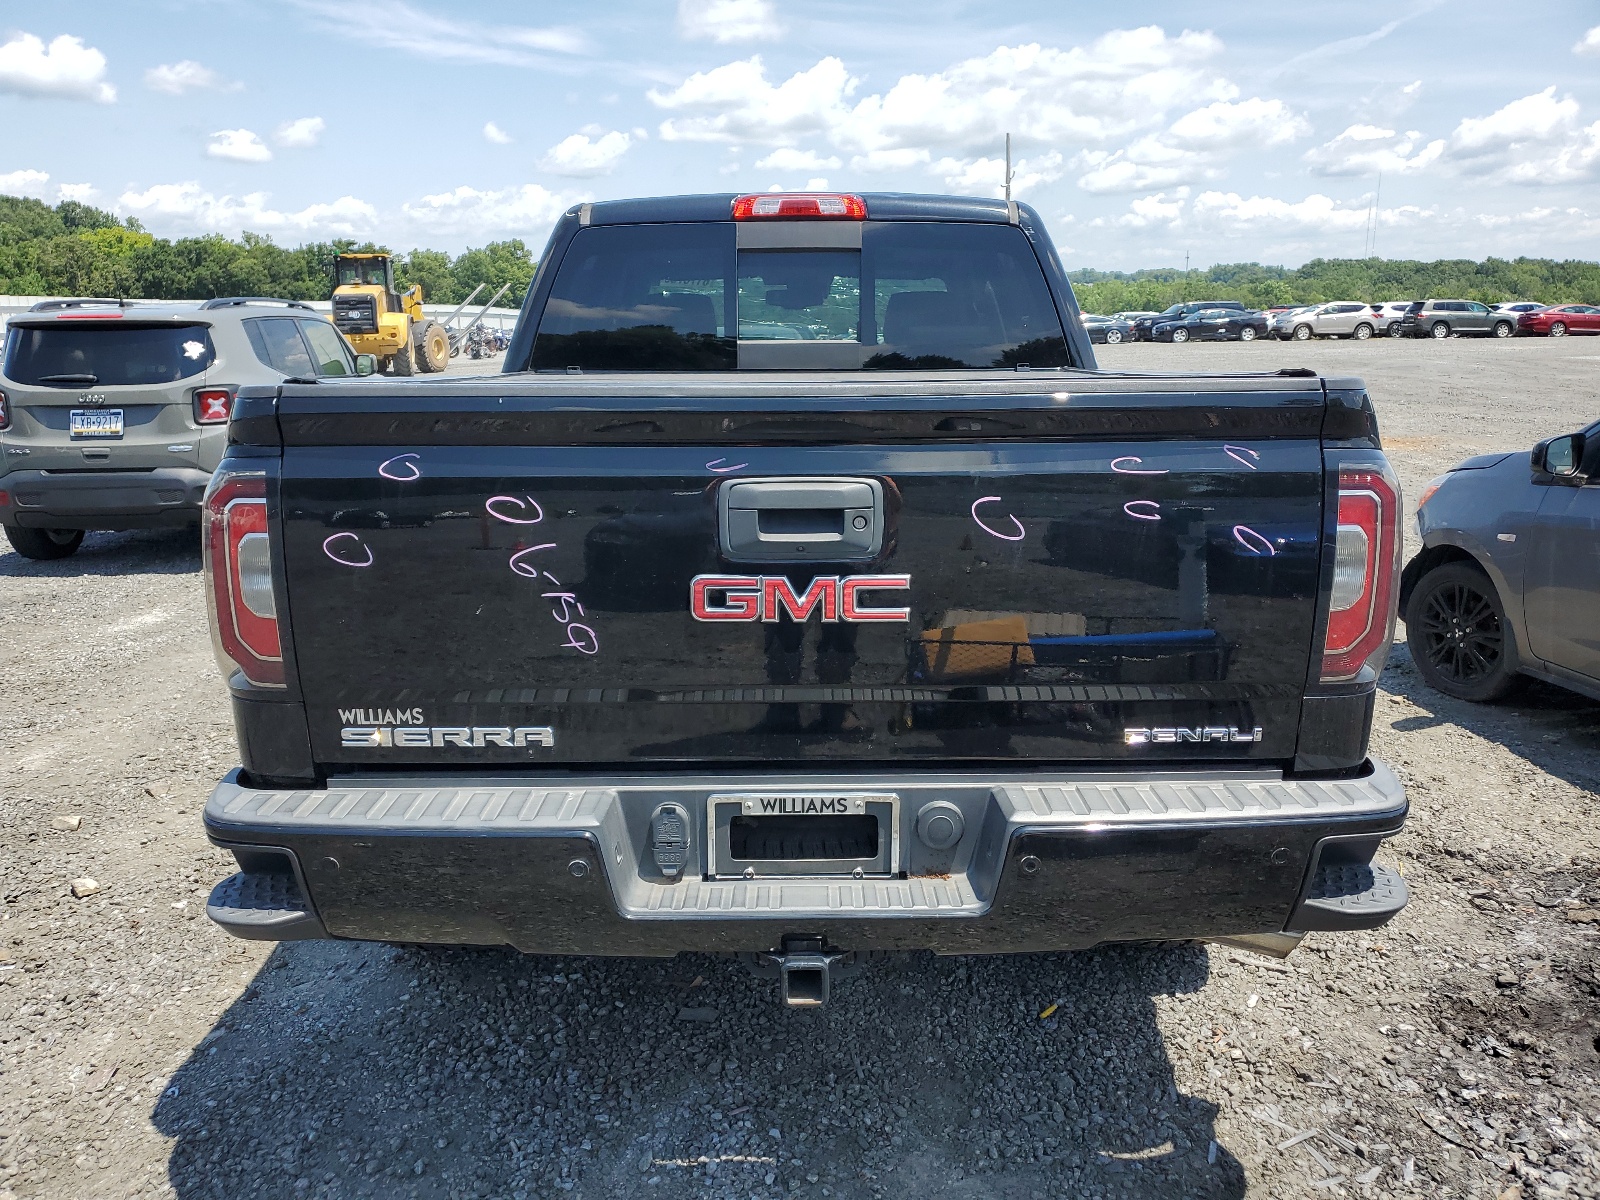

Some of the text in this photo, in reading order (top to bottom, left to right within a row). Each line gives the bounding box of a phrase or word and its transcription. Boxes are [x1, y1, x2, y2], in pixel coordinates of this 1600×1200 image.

[690, 574, 911, 623] GMC
[338, 707, 424, 725] WILLIAMS
[340, 727, 555, 748] SIERRA
[1124, 727, 1263, 743] DENALI
[760, 797, 847, 814] WILLIAMS
